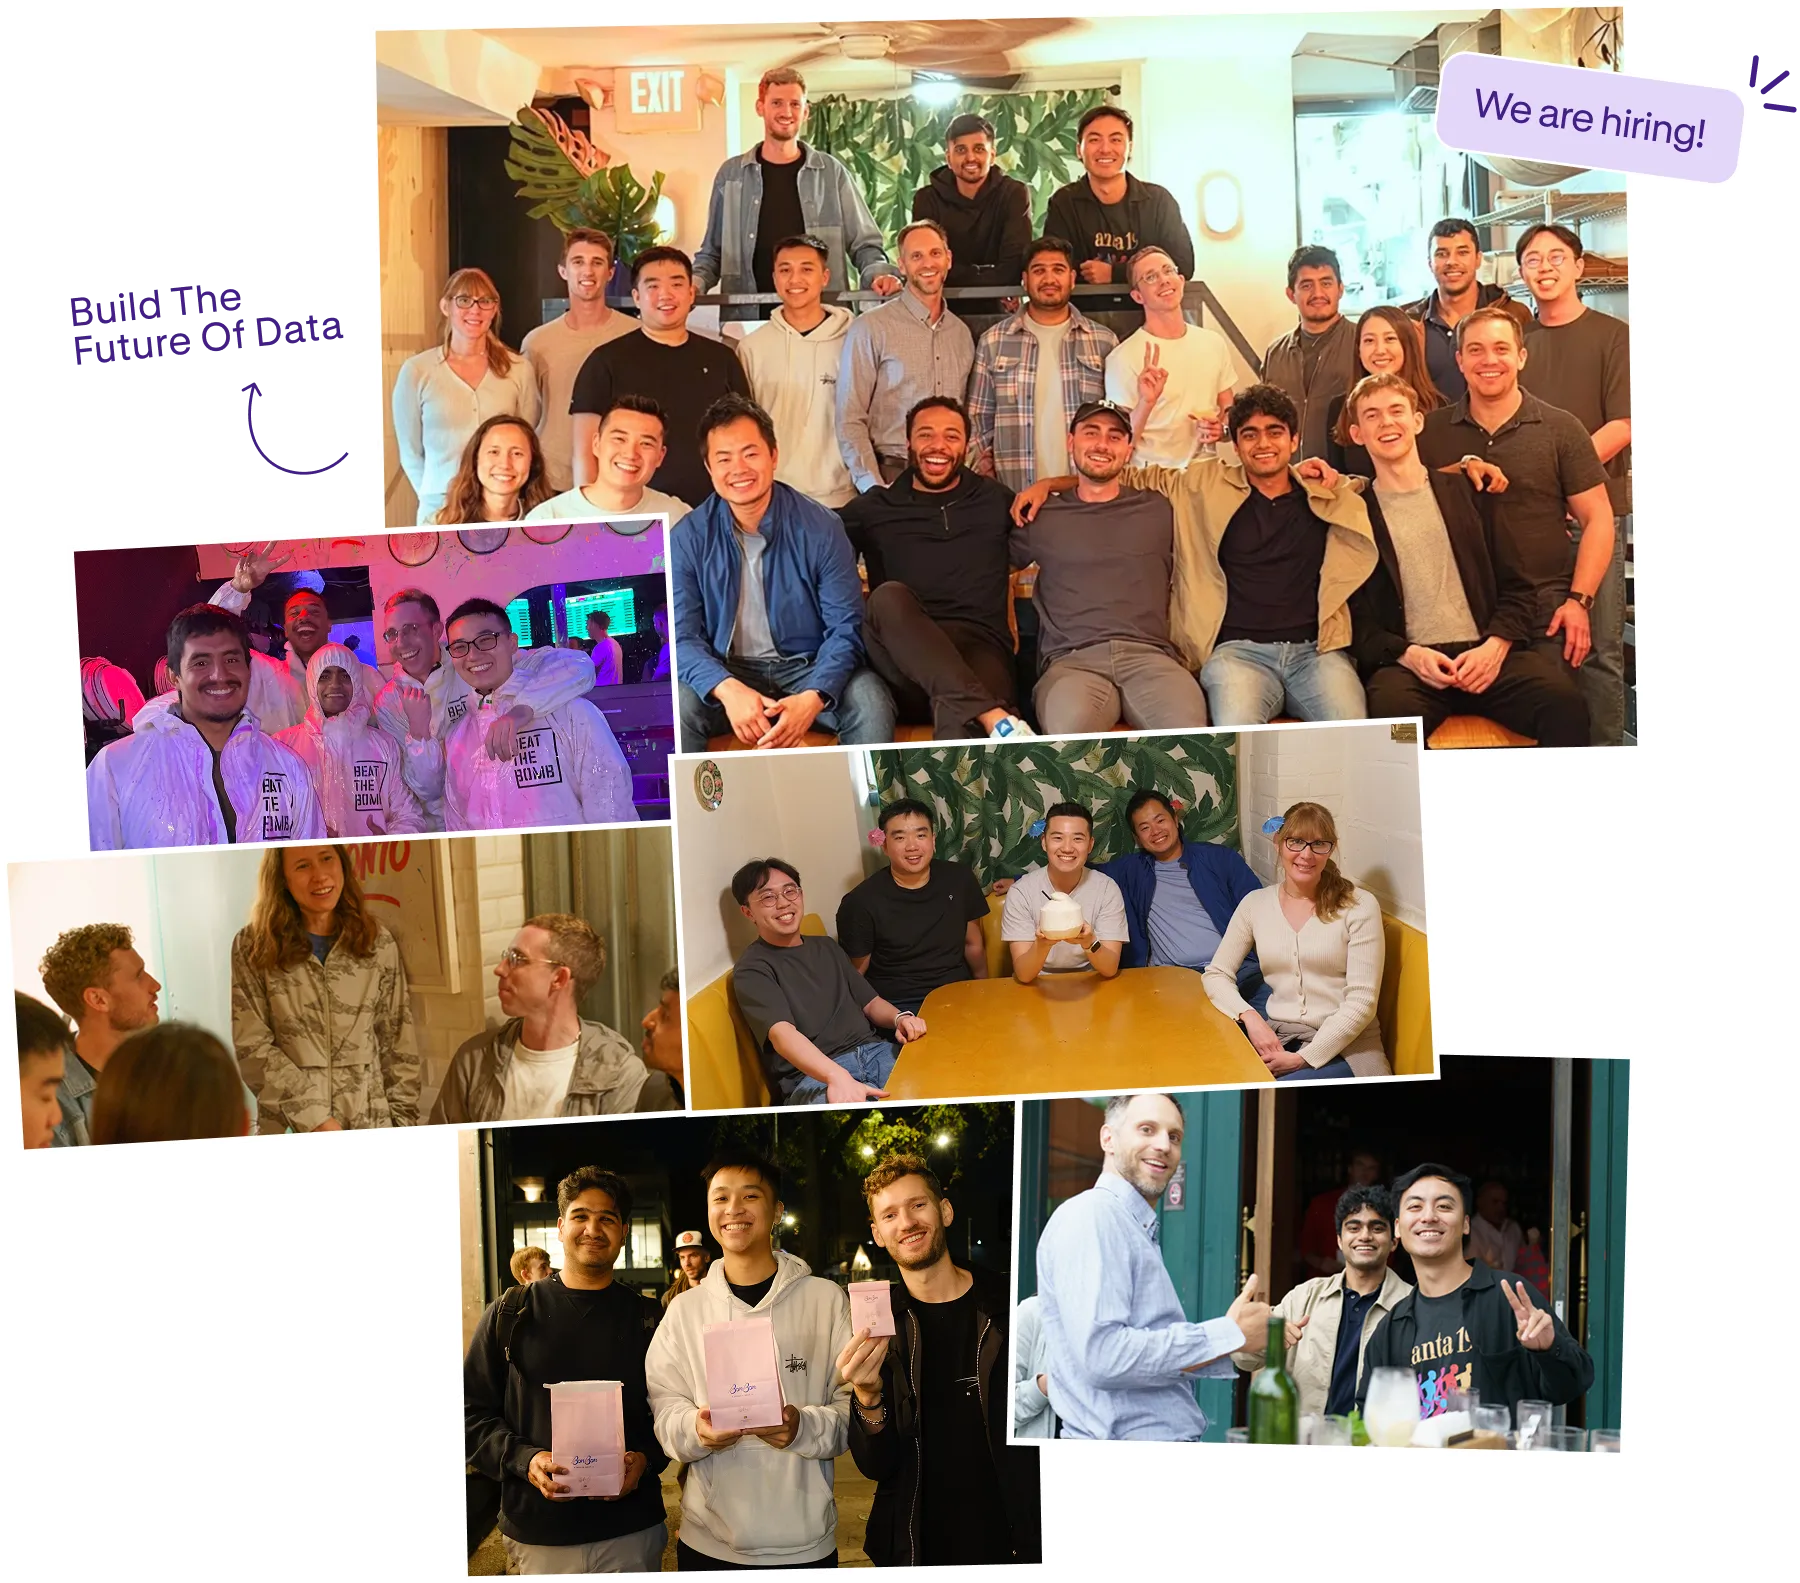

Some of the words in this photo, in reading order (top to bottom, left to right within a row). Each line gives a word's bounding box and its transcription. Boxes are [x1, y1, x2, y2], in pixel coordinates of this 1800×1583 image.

[630, 70, 685, 114] EXIT
[353, 765, 379, 777] BEAT
[514, 764, 555, 782] BOMB
[353, 779, 375, 791] THE
